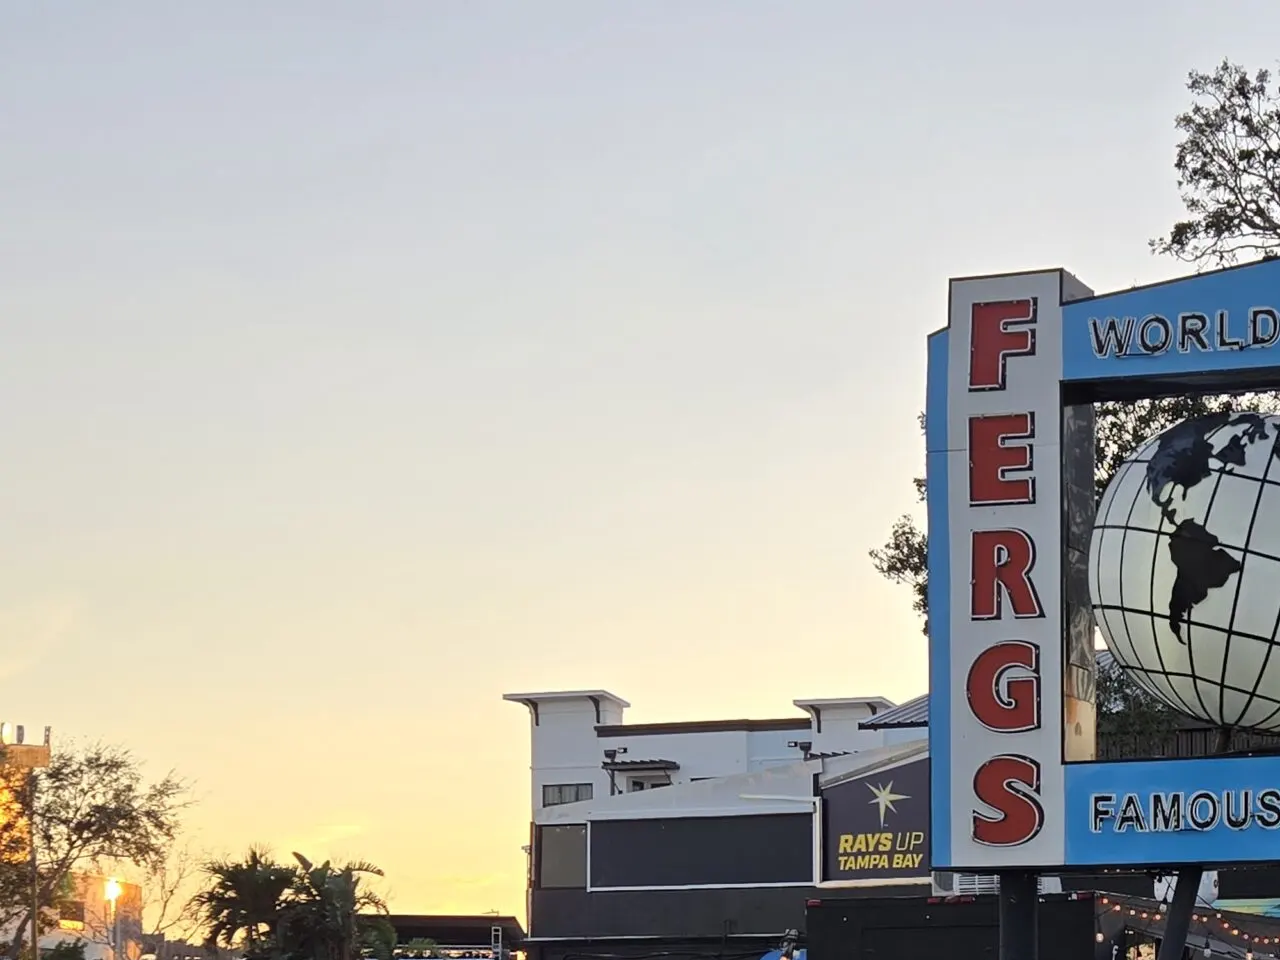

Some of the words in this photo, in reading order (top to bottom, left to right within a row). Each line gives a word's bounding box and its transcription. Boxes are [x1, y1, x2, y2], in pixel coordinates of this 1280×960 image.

[966, 296, 1046, 847] FERGS
[838, 833, 893, 853] RAYS
[896, 832, 924, 851] UP
[838, 855, 889, 870] TAMPA
[892, 854, 923, 868] BAY
